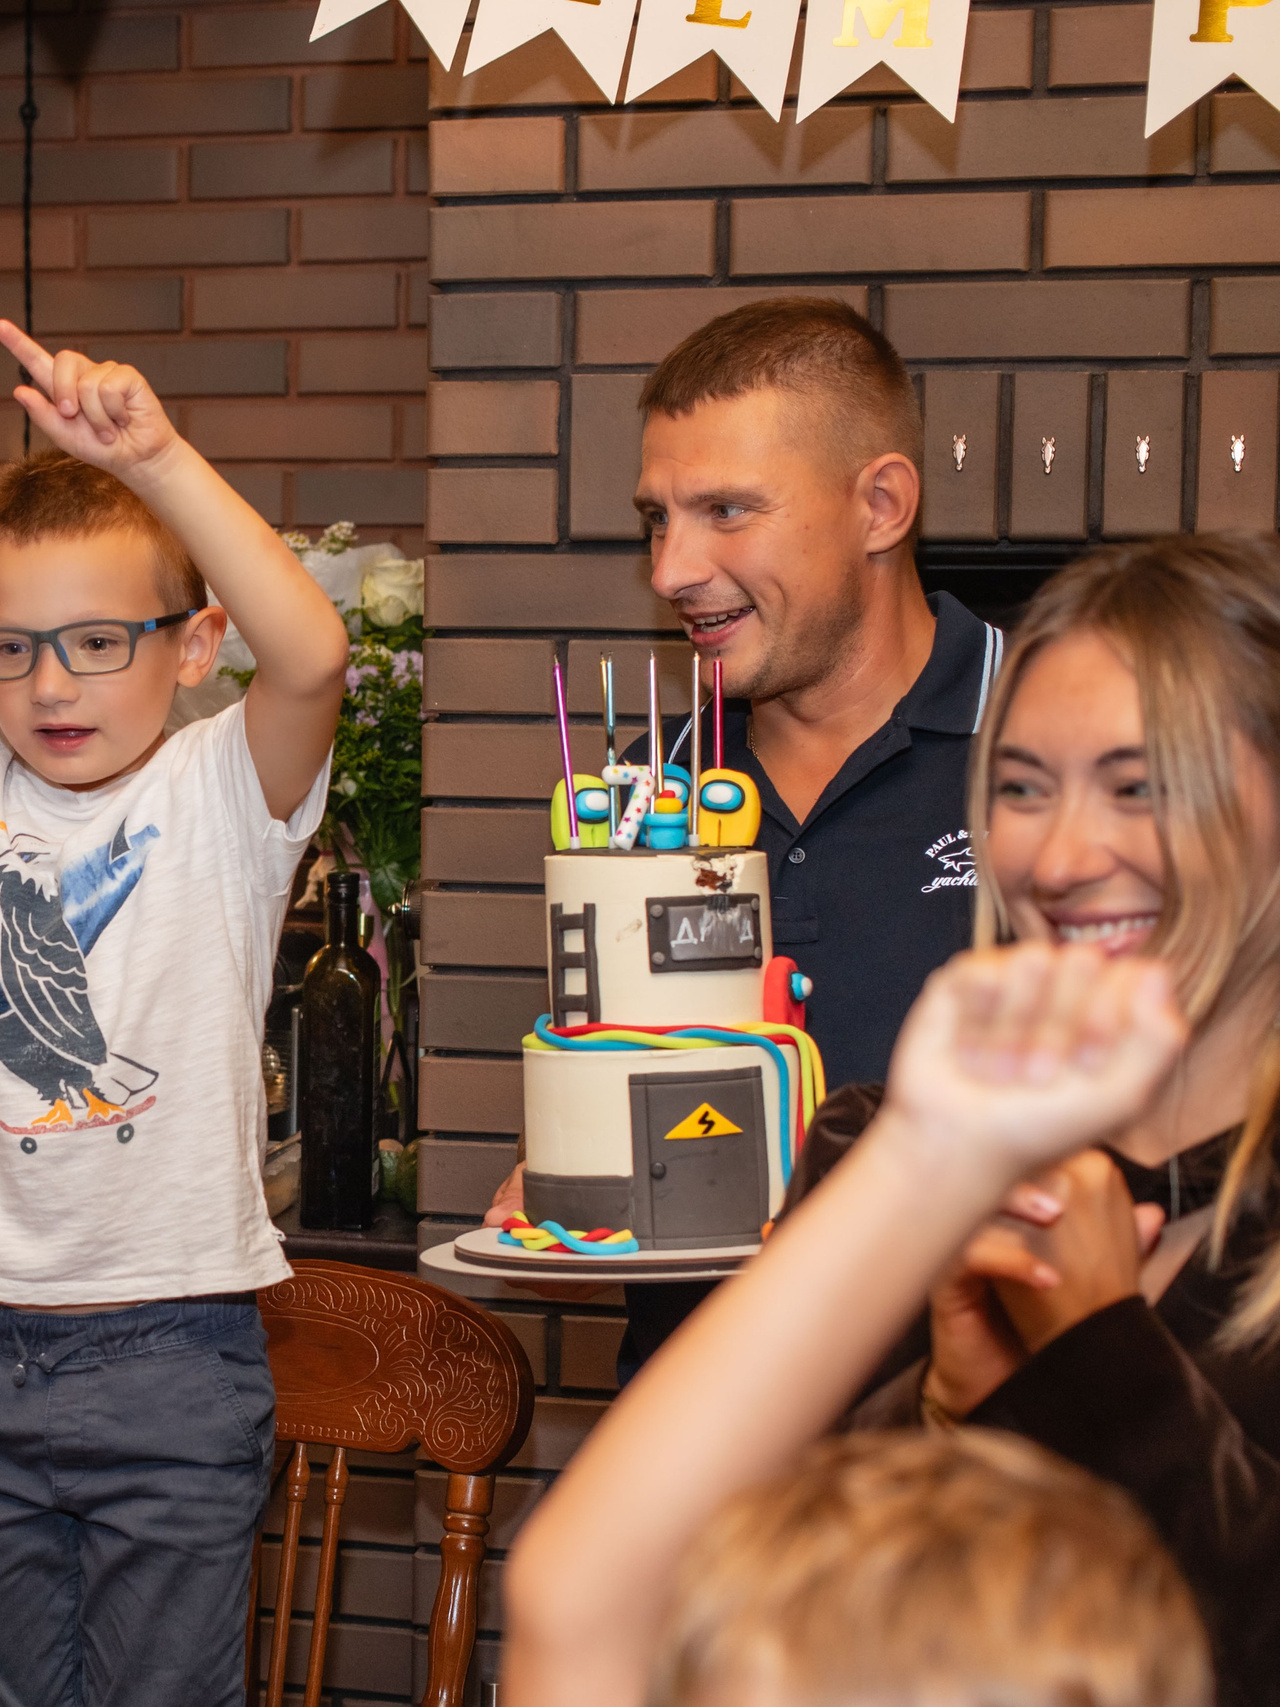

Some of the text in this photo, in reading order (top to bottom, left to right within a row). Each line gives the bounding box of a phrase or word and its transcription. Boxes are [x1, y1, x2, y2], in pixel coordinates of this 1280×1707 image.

[924, 833, 957, 858] PAUL
[957, 829, 969, 840] &
[921, 868, 979, 893] yacht
